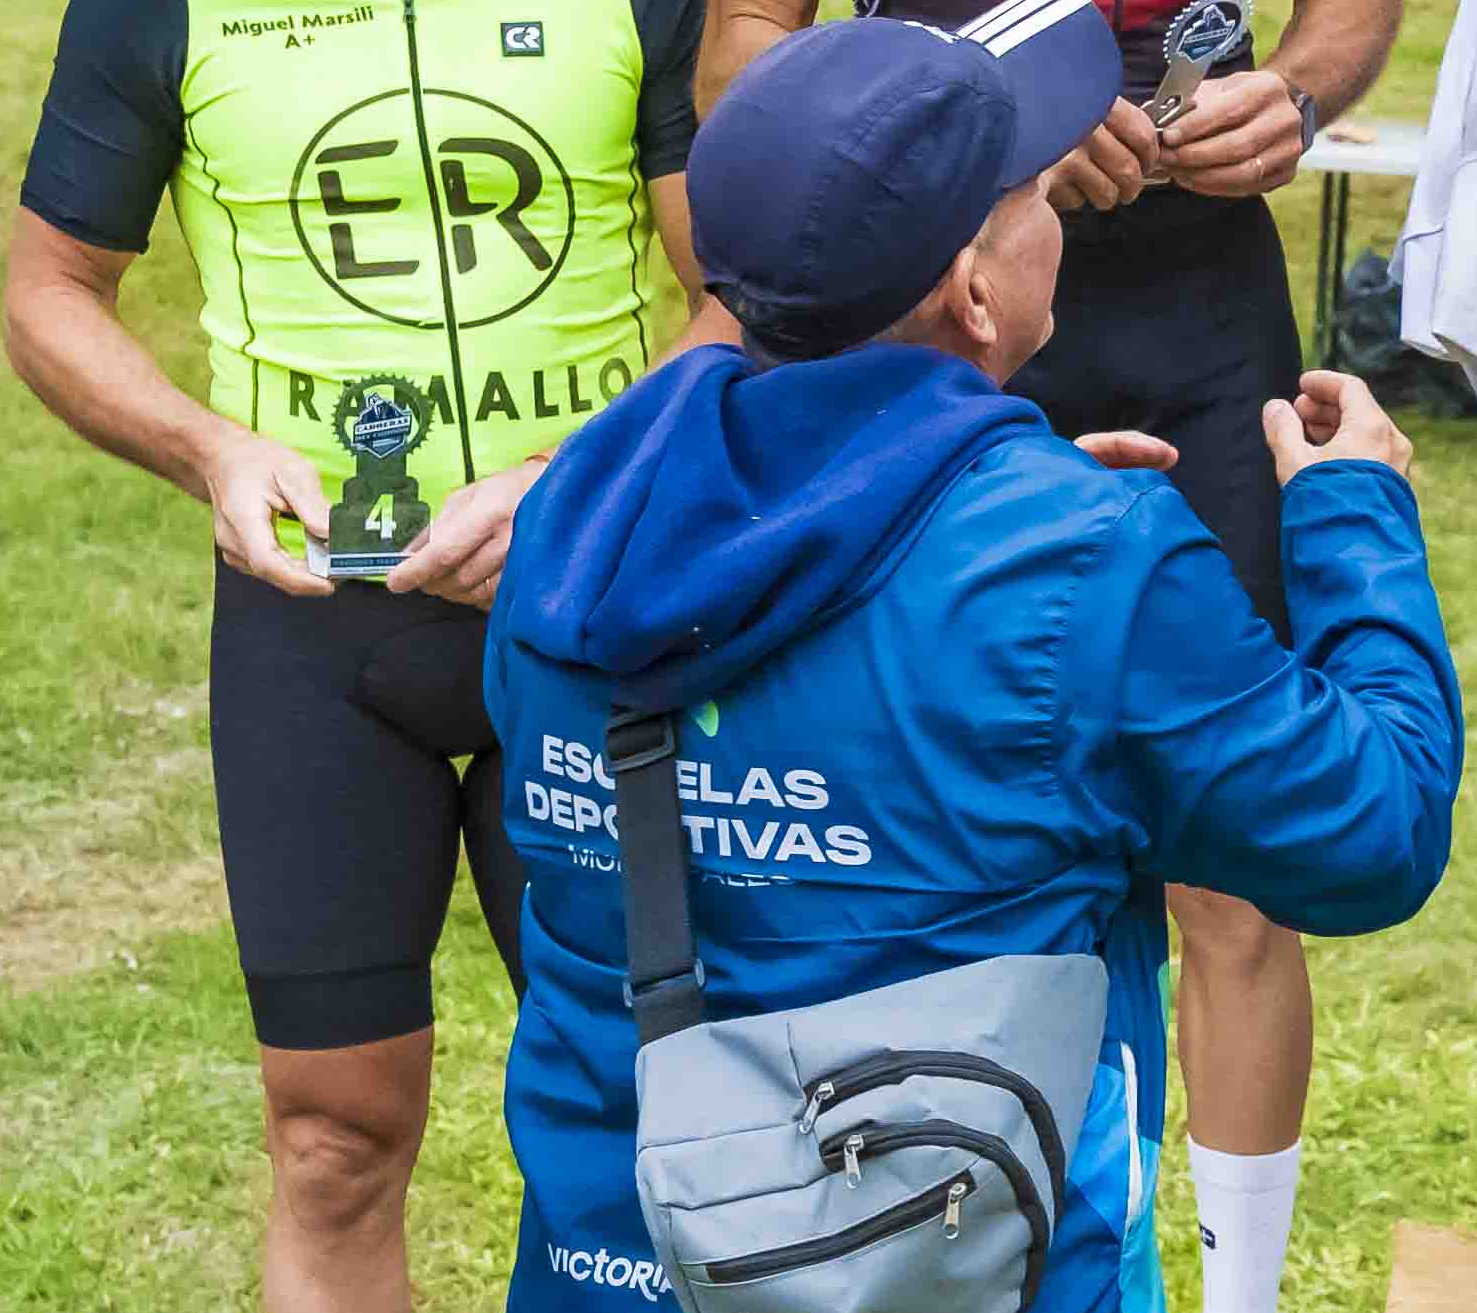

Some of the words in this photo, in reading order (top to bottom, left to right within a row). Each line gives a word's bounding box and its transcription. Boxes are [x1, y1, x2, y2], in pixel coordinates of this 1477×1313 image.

[222, 15, 295, 38] Miguel
[302, 4, 376, 29] Marsili
[284, 34, 317, 50] A+
[314, 136, 555, 280] ER
[364, 493, 397, 539] 4
[542, 734, 830, 811] ESCELAS
[524, 781, 873, 867] DEPTIVAS
